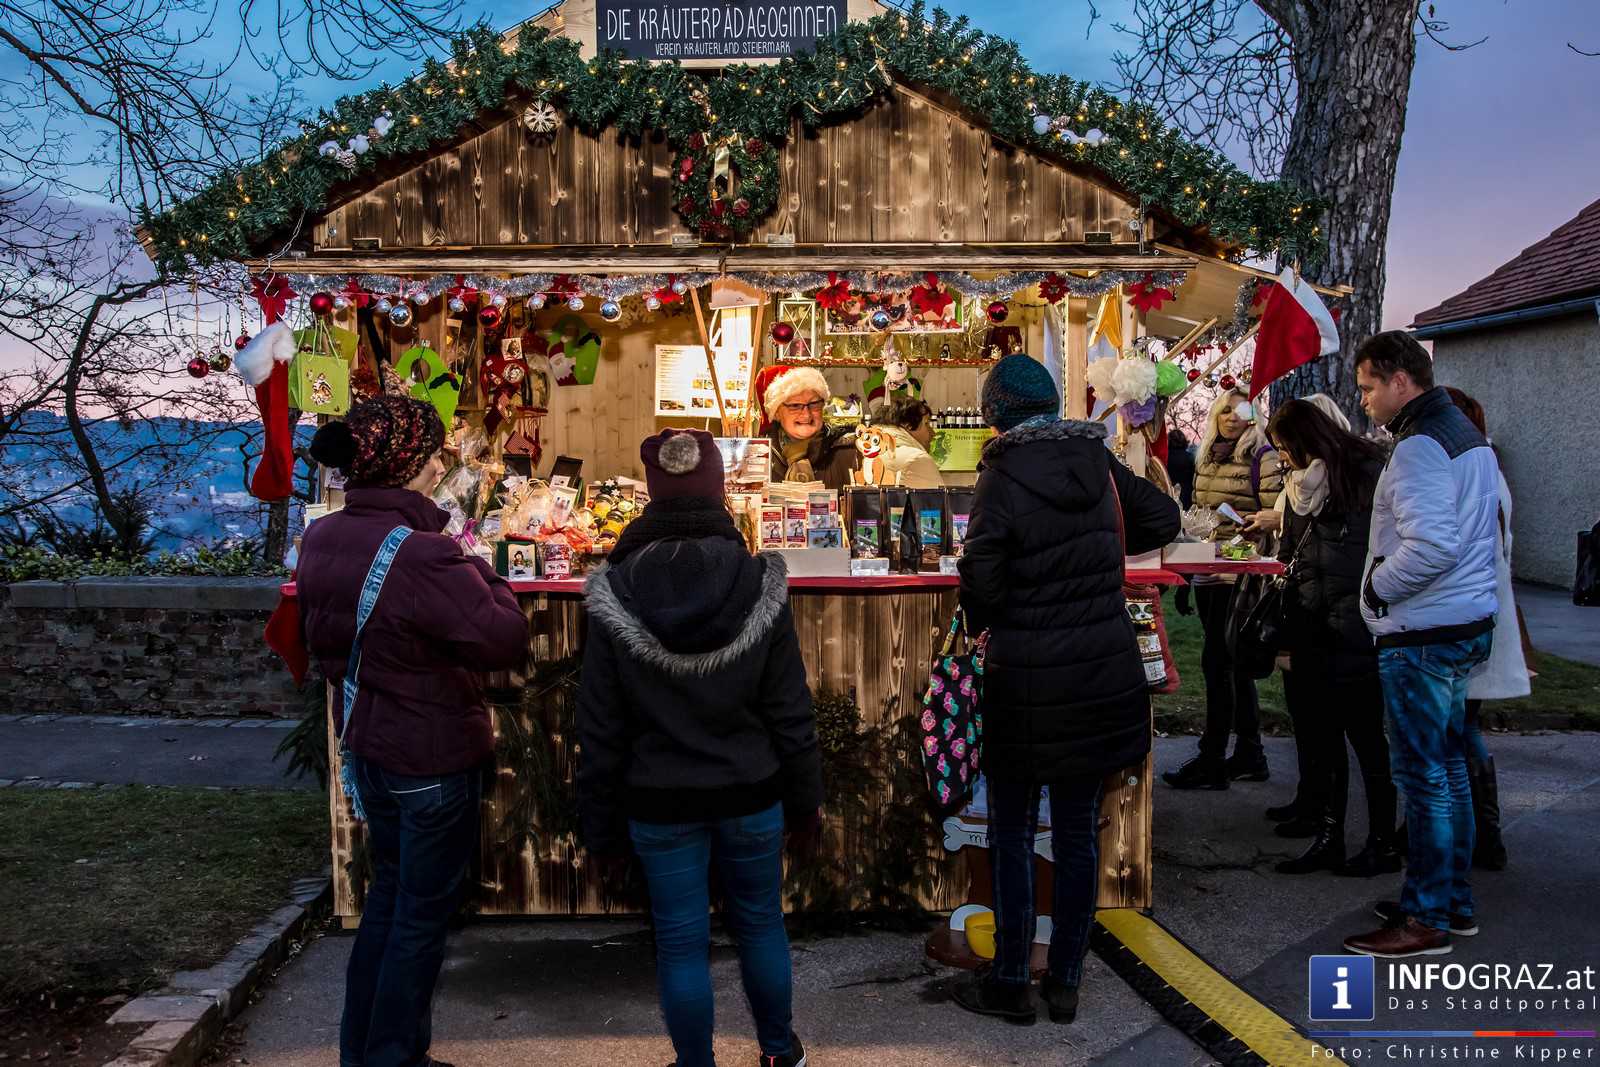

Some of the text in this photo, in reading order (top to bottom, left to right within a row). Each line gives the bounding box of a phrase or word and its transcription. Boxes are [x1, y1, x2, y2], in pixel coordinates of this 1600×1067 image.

[606, 9, 632, 41] DIE
[655, 42, 682, 56] VEREIN
[742, 40, 791, 55] STEIERMARK
